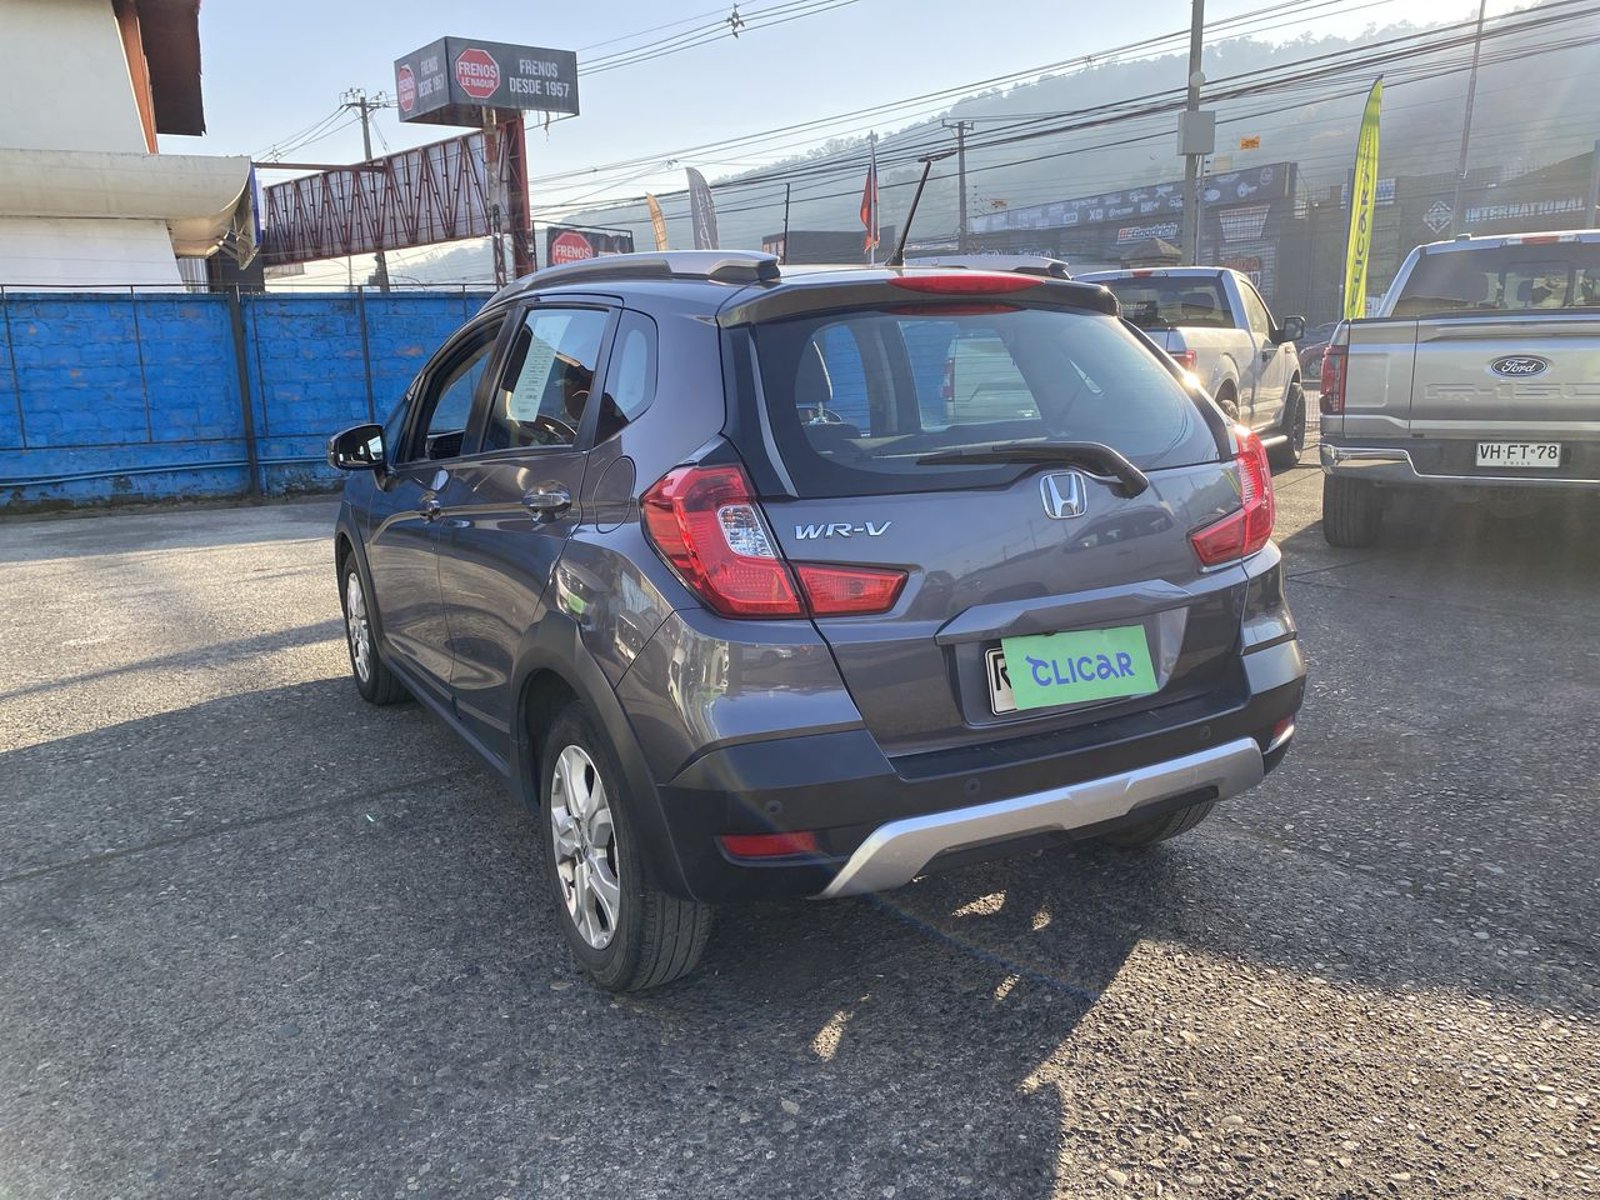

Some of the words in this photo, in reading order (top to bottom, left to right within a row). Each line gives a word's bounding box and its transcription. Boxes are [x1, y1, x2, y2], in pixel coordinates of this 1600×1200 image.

[458, 61, 497, 79] FRENOS
[519, 59, 558, 78] FRENOS
[461, 76, 470, 86] LE
[509, 77, 542, 95] DESDE
[545, 81, 570, 98] 1957
[555, 244, 592, 260] FRENOS
[1501, 358, 1537, 374] Ford
[795, 521, 892, 540] WR-V
